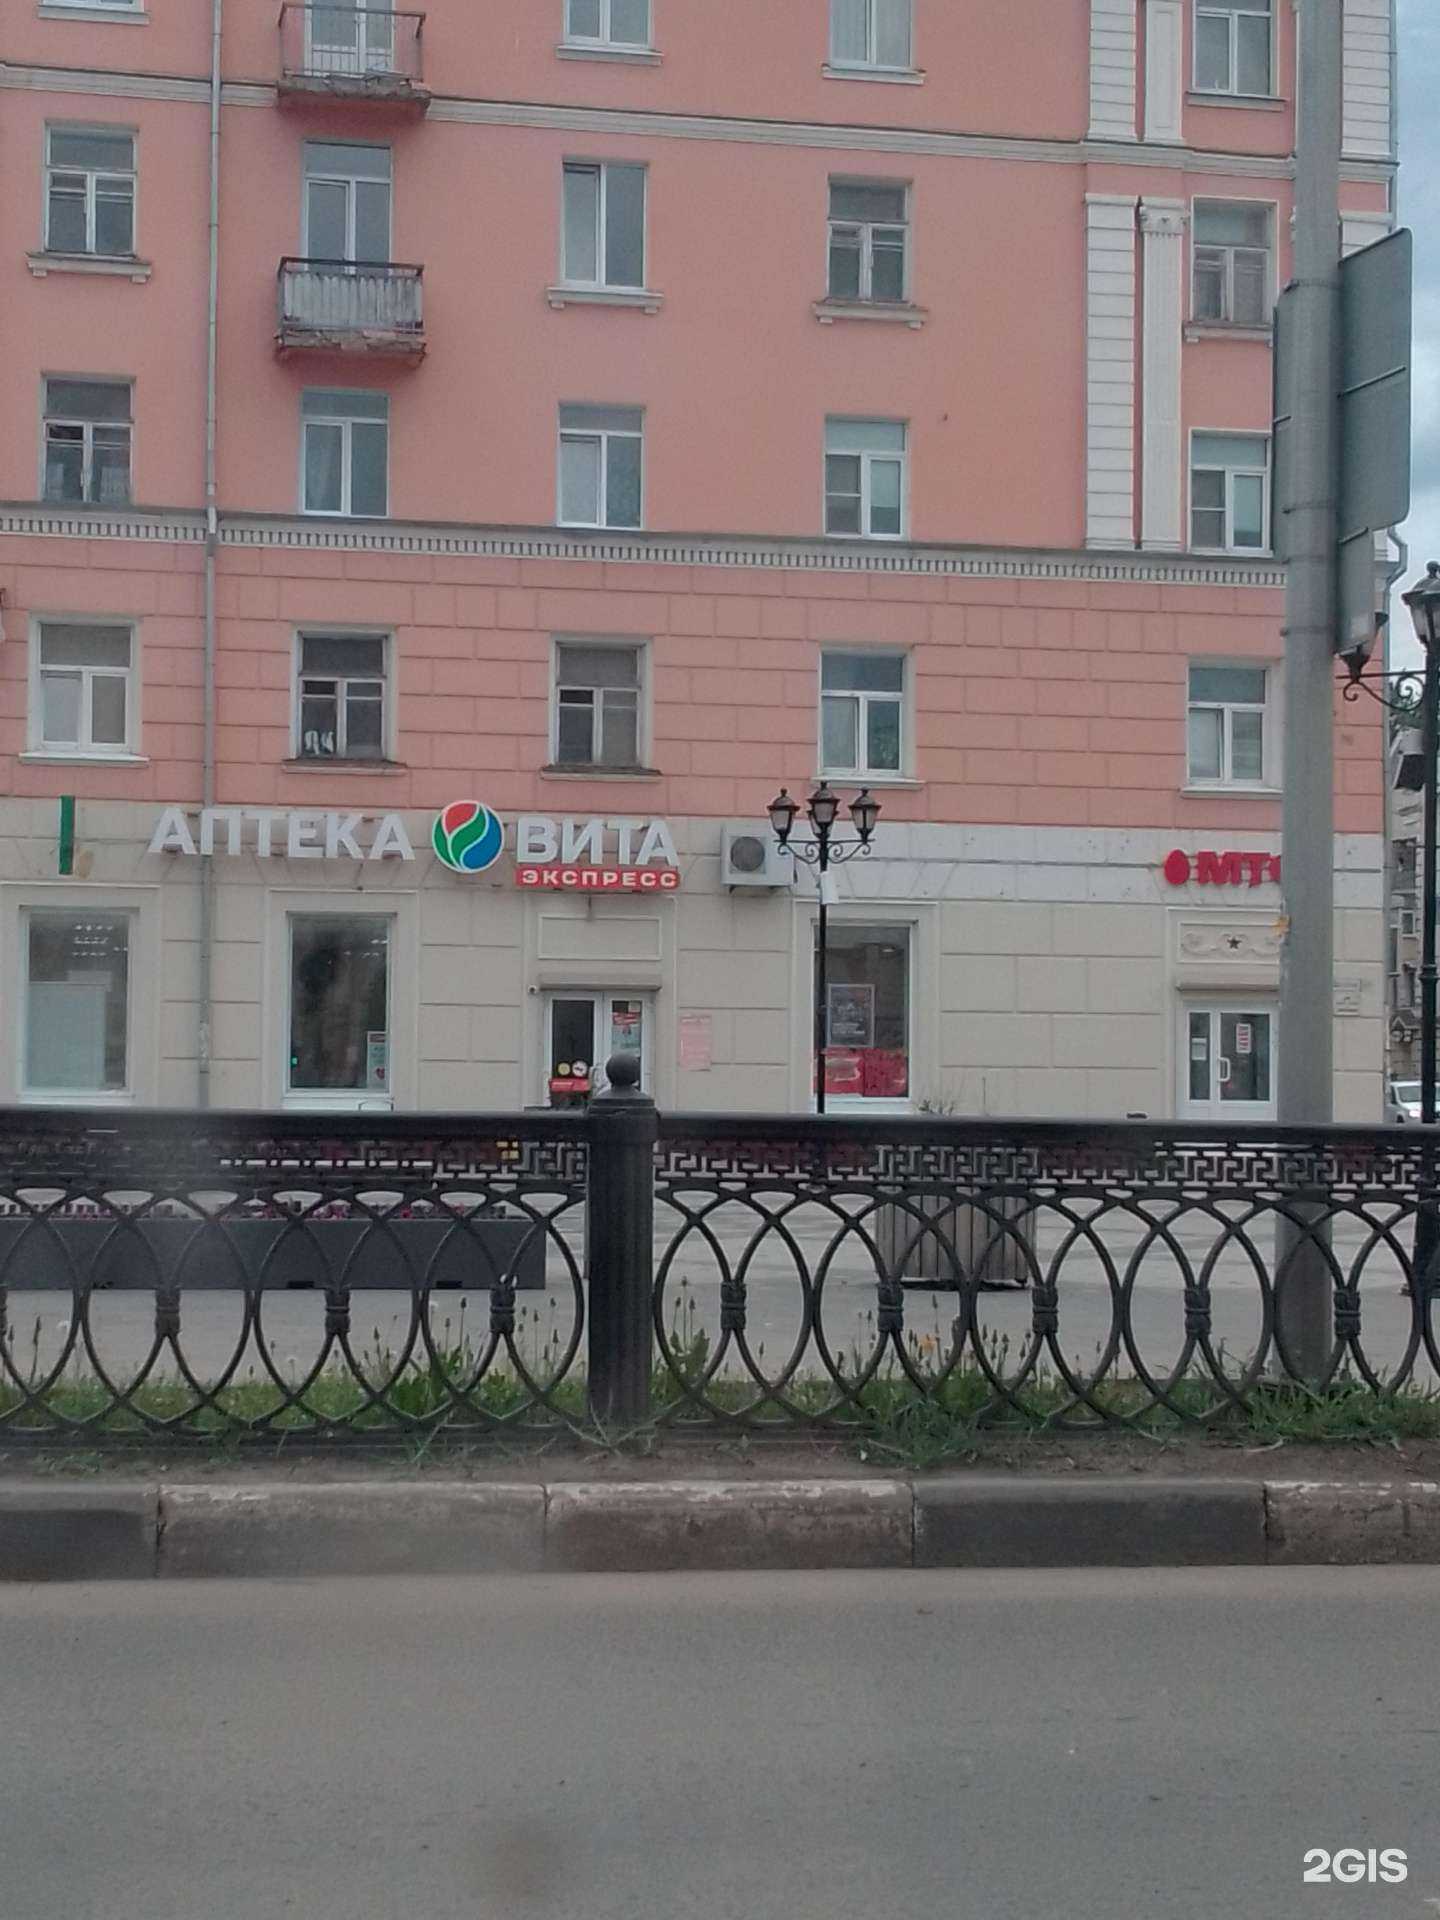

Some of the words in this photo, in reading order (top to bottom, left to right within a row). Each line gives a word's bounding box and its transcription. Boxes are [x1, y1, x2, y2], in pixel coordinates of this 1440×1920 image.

[147, 806, 417, 861] АПТЕКА
[516, 814, 681, 866] ВИТА
[521, 870, 678, 887] ЭКСПРЕСС
